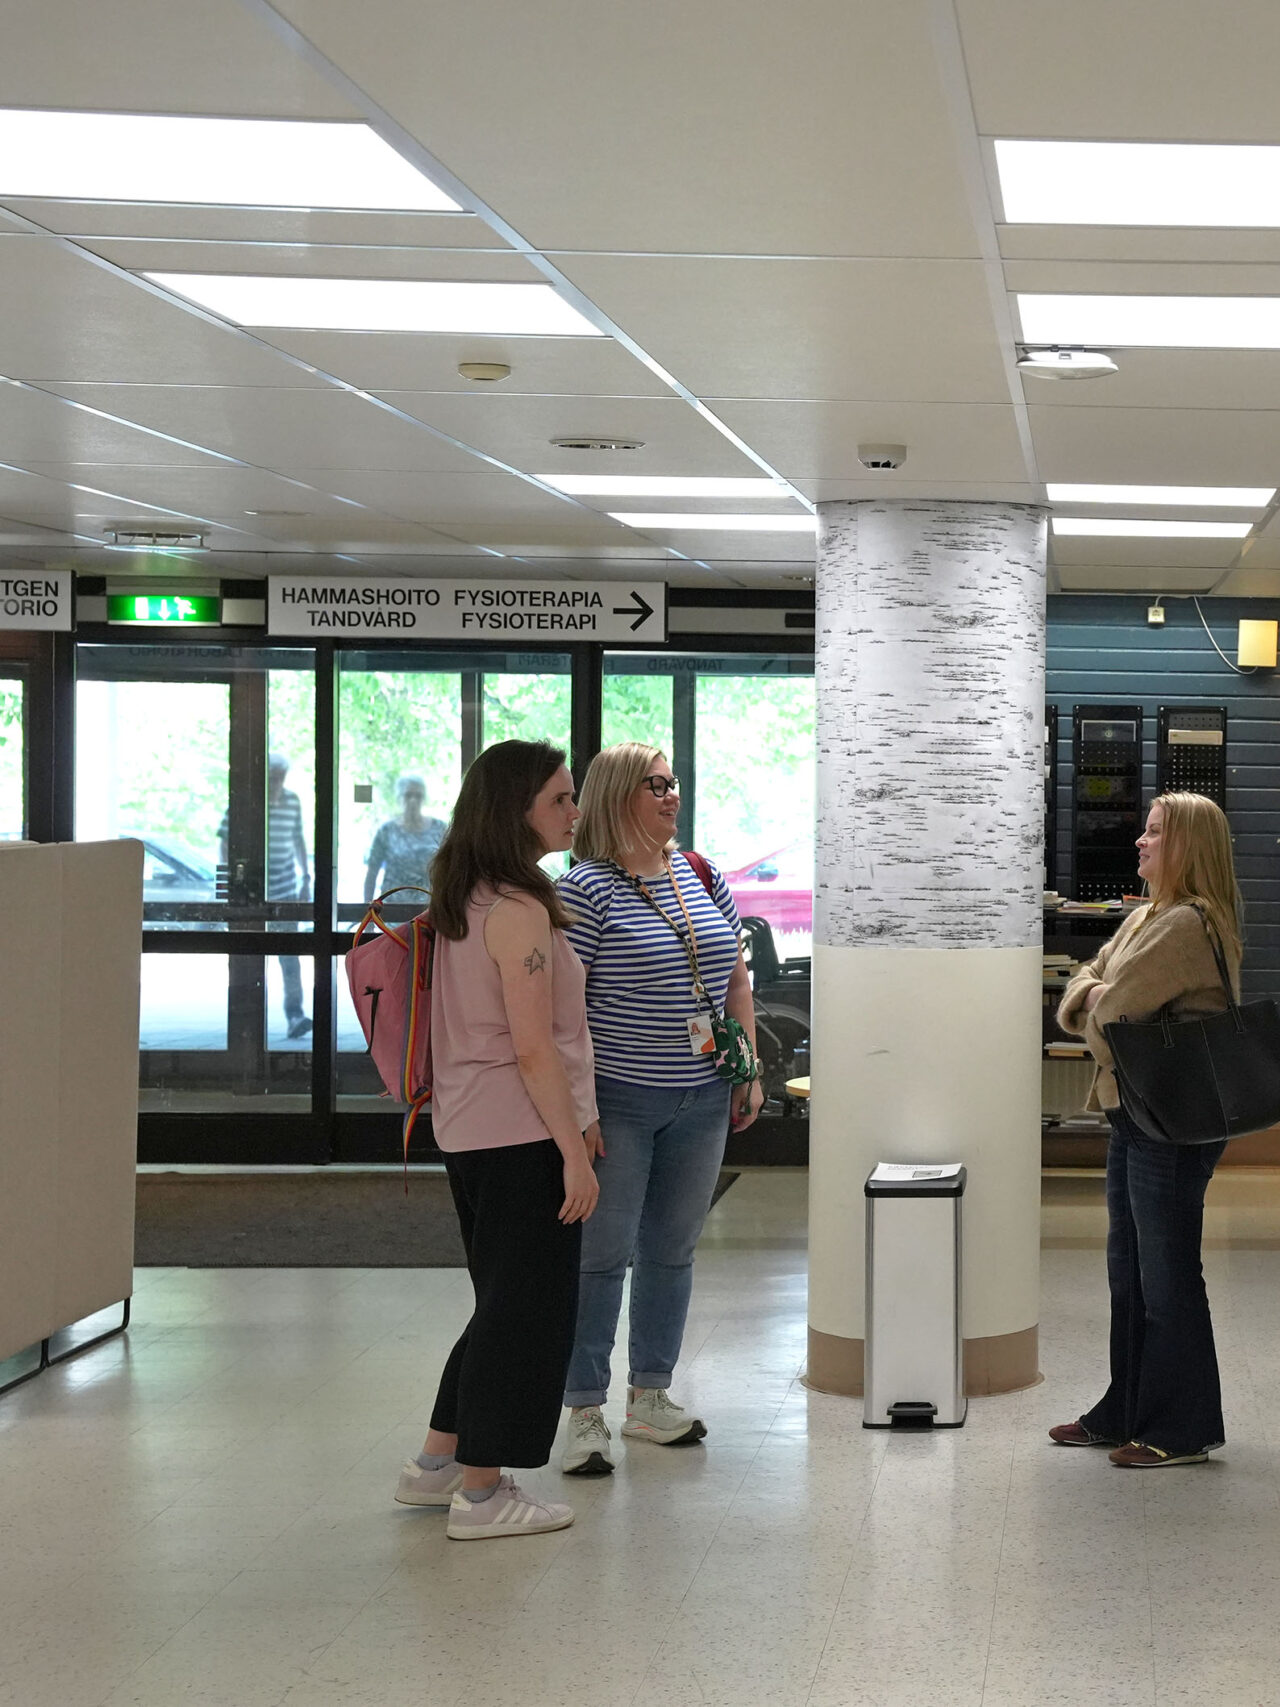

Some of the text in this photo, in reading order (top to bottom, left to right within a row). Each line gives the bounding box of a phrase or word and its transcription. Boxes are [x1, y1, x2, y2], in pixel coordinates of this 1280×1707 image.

[0, 580, 58, 597] TGEN
[281, 587, 603, 608] HAMMASHOITO FYSIOTERAPIA
[0, 599, 58, 616] ORIO
[307, 607, 597, 630] TANDVÅRD FYSIOTERAPI
